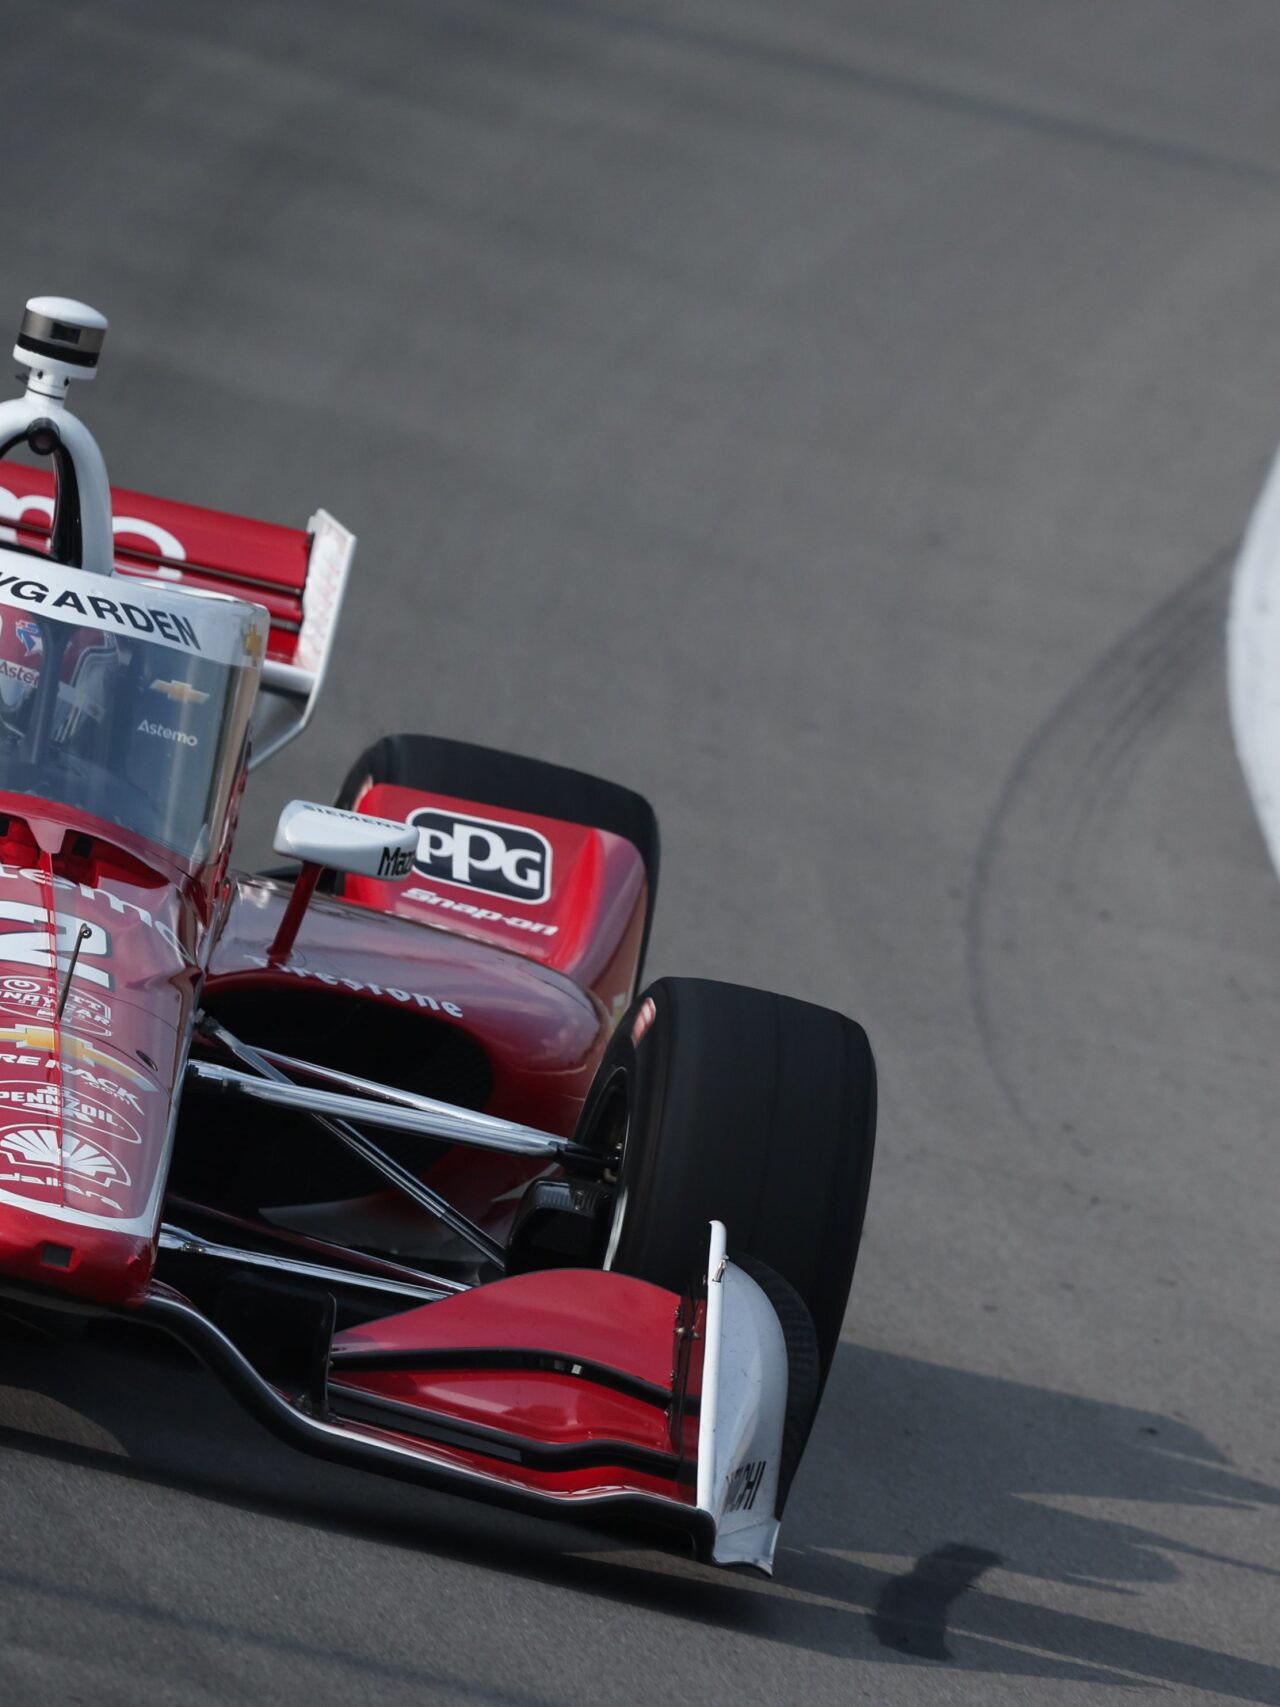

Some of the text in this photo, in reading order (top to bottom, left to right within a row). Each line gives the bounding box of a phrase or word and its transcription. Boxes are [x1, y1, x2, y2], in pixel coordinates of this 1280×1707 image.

[137, 719, 198, 747] Astemo
[415, 822, 542, 890] PPG
[401, 887, 560, 937] Snap-on
[45, 1059, 145, 1116] RACK
